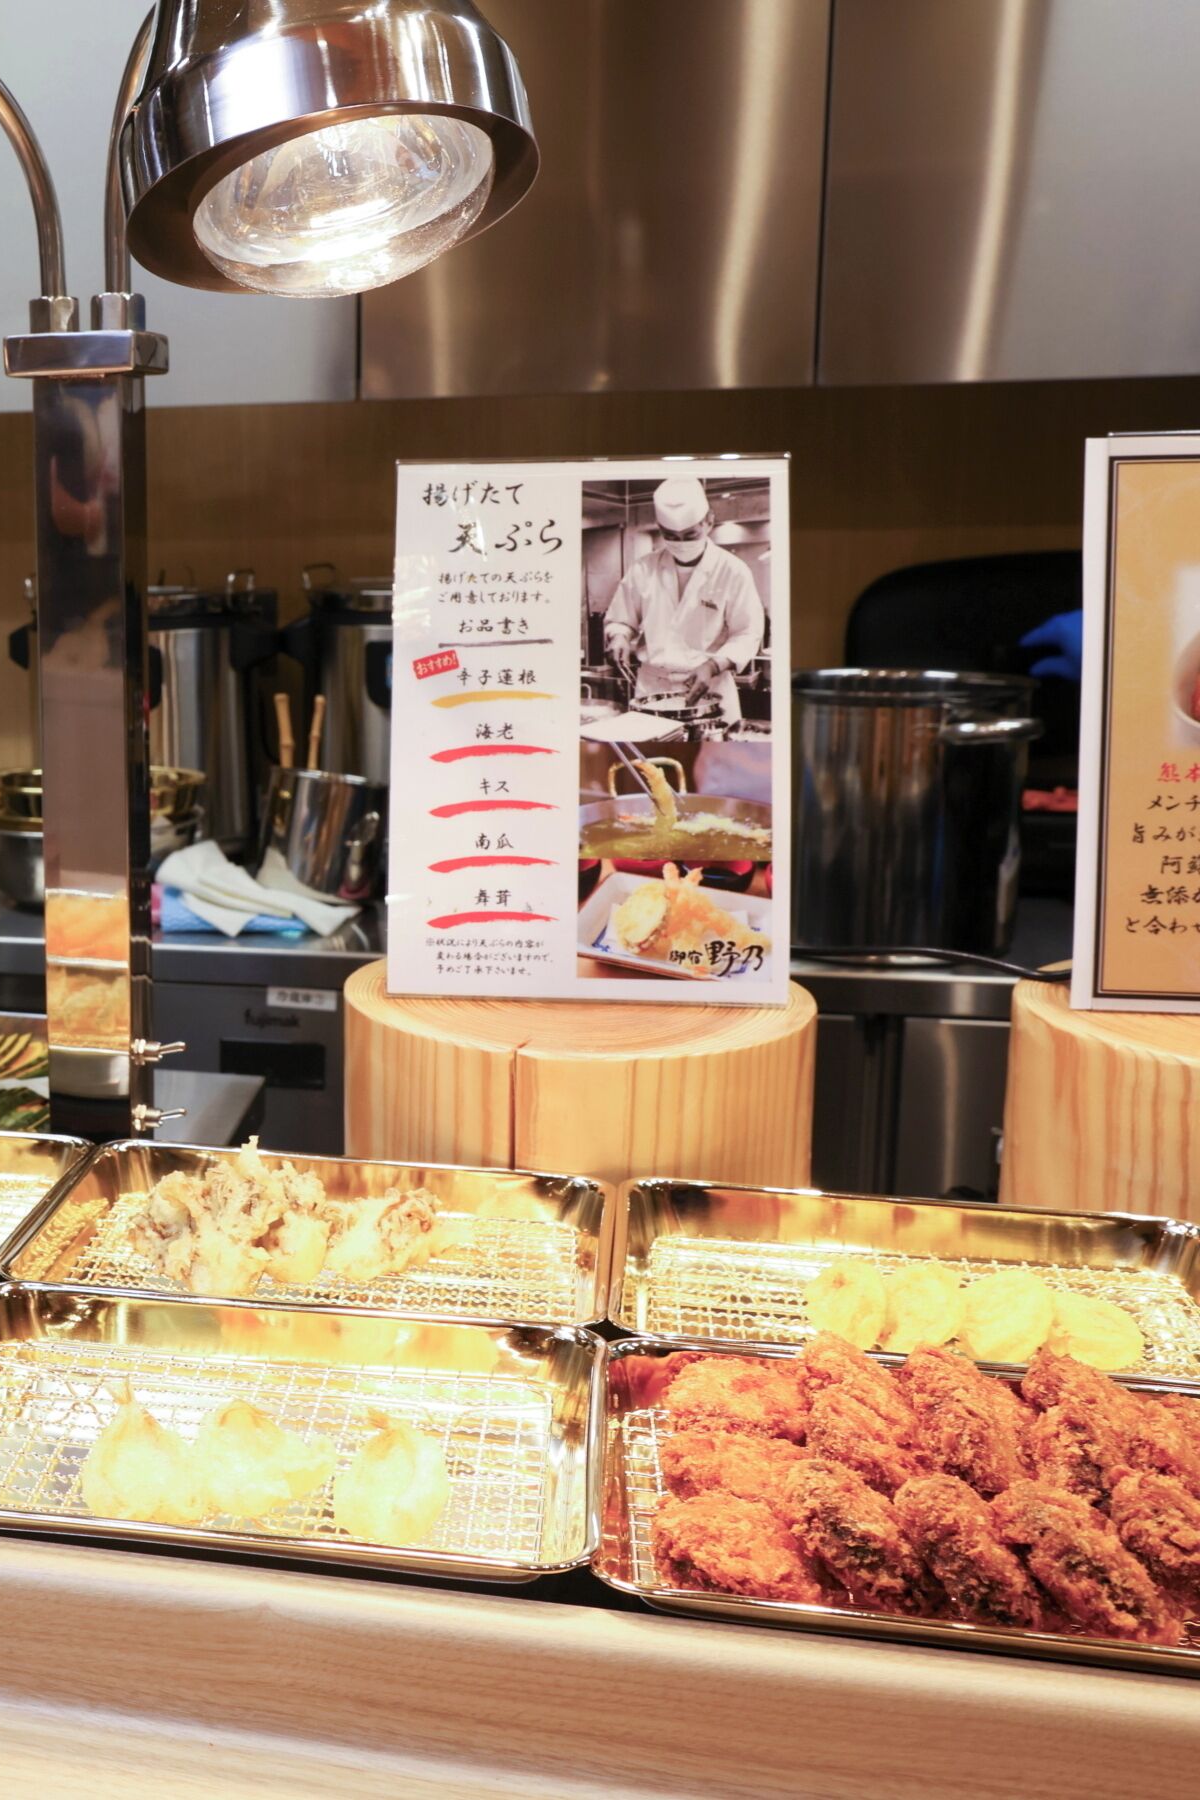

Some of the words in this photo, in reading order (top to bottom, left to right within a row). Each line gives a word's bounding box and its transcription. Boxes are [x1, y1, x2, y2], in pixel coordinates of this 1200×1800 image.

[422, 480, 524, 507] 揚げたて
[448, 519, 563, 555] 天ぷら
[438, 571, 554, 584] 揚げたての天ぷらを
[438, 590, 551, 603] ご用意しております。
[459, 616, 529, 634] お品書き
[457, 667, 537, 685] 辛子蓮根
[475, 723, 515, 740] 海老
[479, 779, 511, 793] キス
[475, 833, 515, 850] 南瓜
[1132, 822, 1200, 843] 旨みが
[474, 889, 513, 907] 舞茸
[669, 949, 703, 965] 御宿
[704, 940, 764, 977] 野乃
